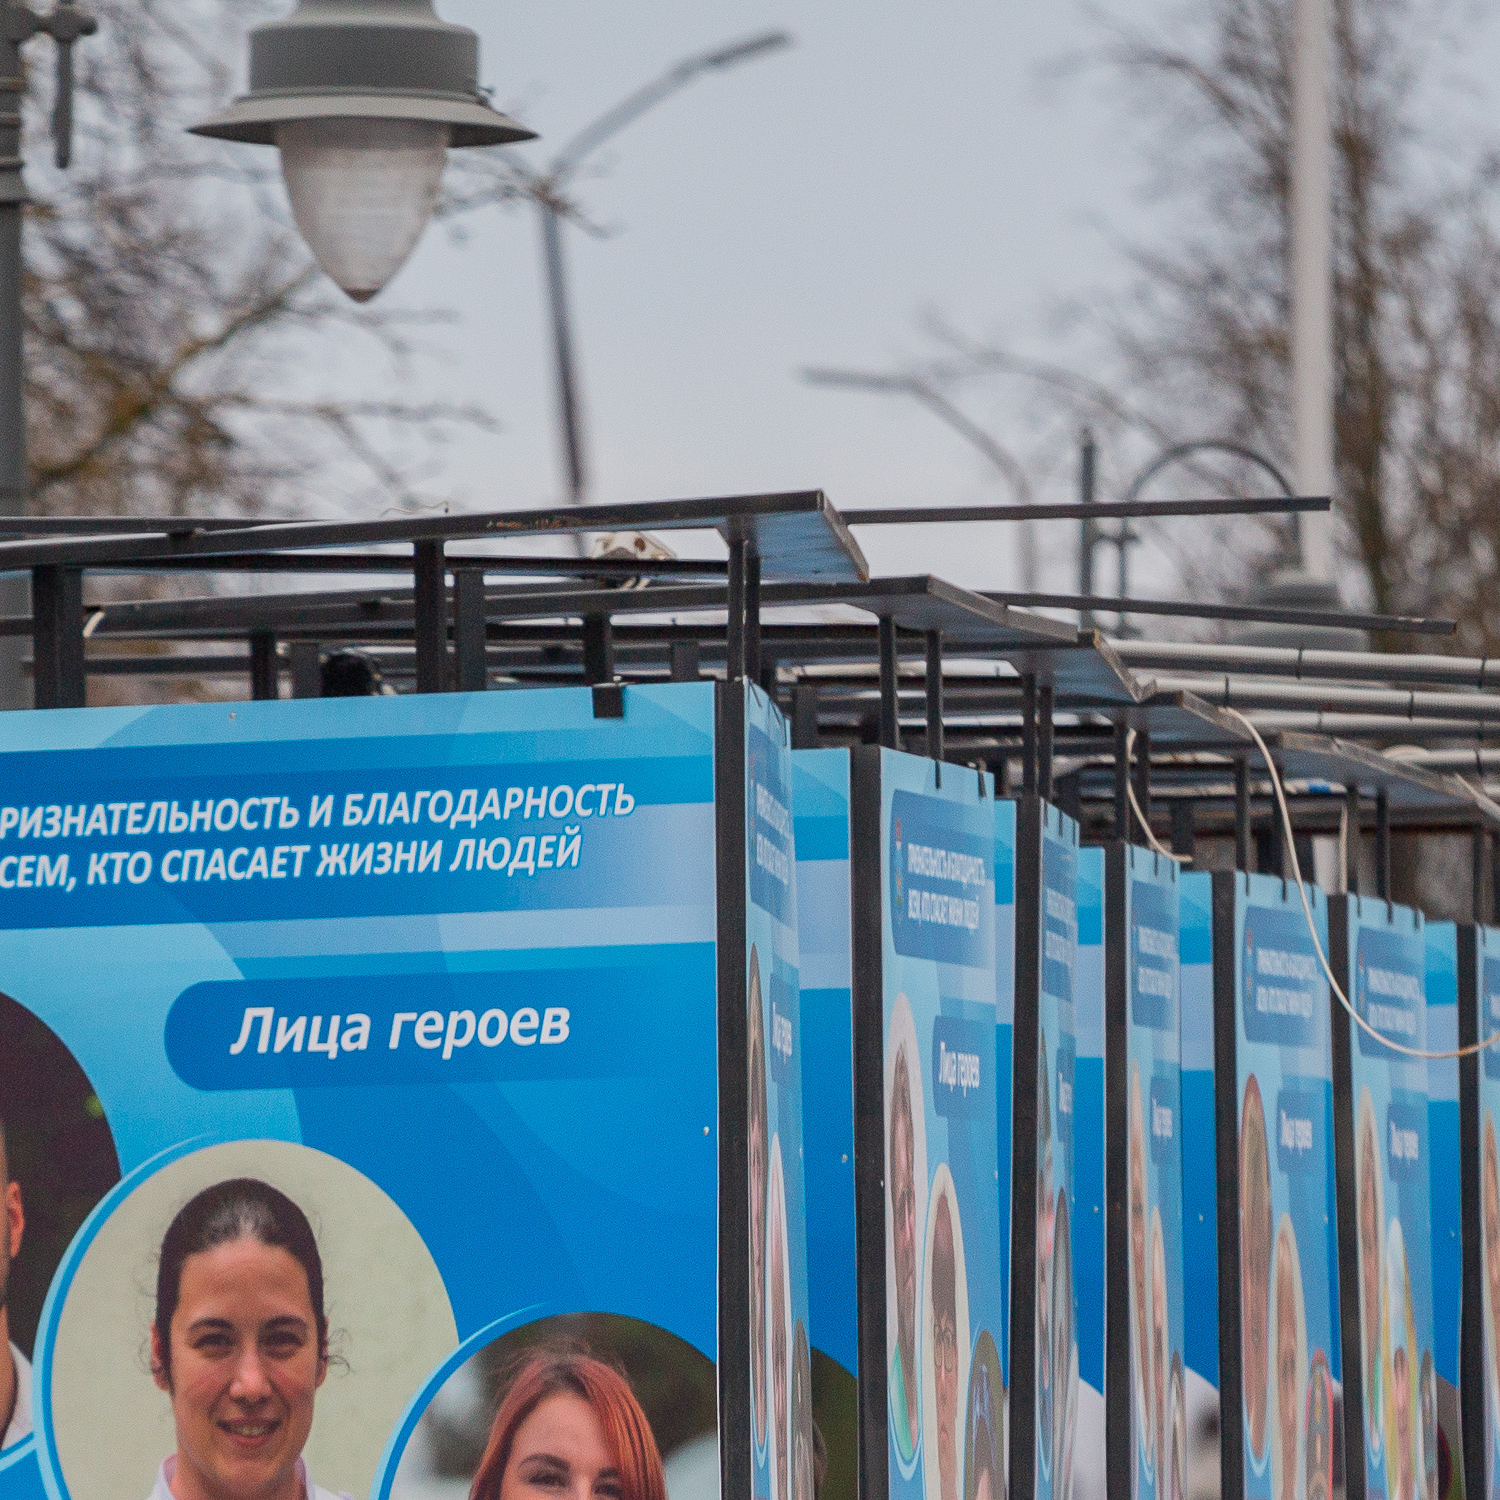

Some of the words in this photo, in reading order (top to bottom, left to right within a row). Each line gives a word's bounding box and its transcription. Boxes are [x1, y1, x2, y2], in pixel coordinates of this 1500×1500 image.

[308, 794, 334, 828] И
[342, 781, 637, 830] БЛАГОДАРНОСТЬ
[86, 850, 153, 885] КТО
[160, 844, 311, 883] СПАСАЕТ
[315, 839, 443, 877] ЖИЗНИ
[449, 825, 584, 877] ЛЮДЕЙ
[229, 1006, 372, 1060] Лица
[388, 1006, 571, 1060] героев
